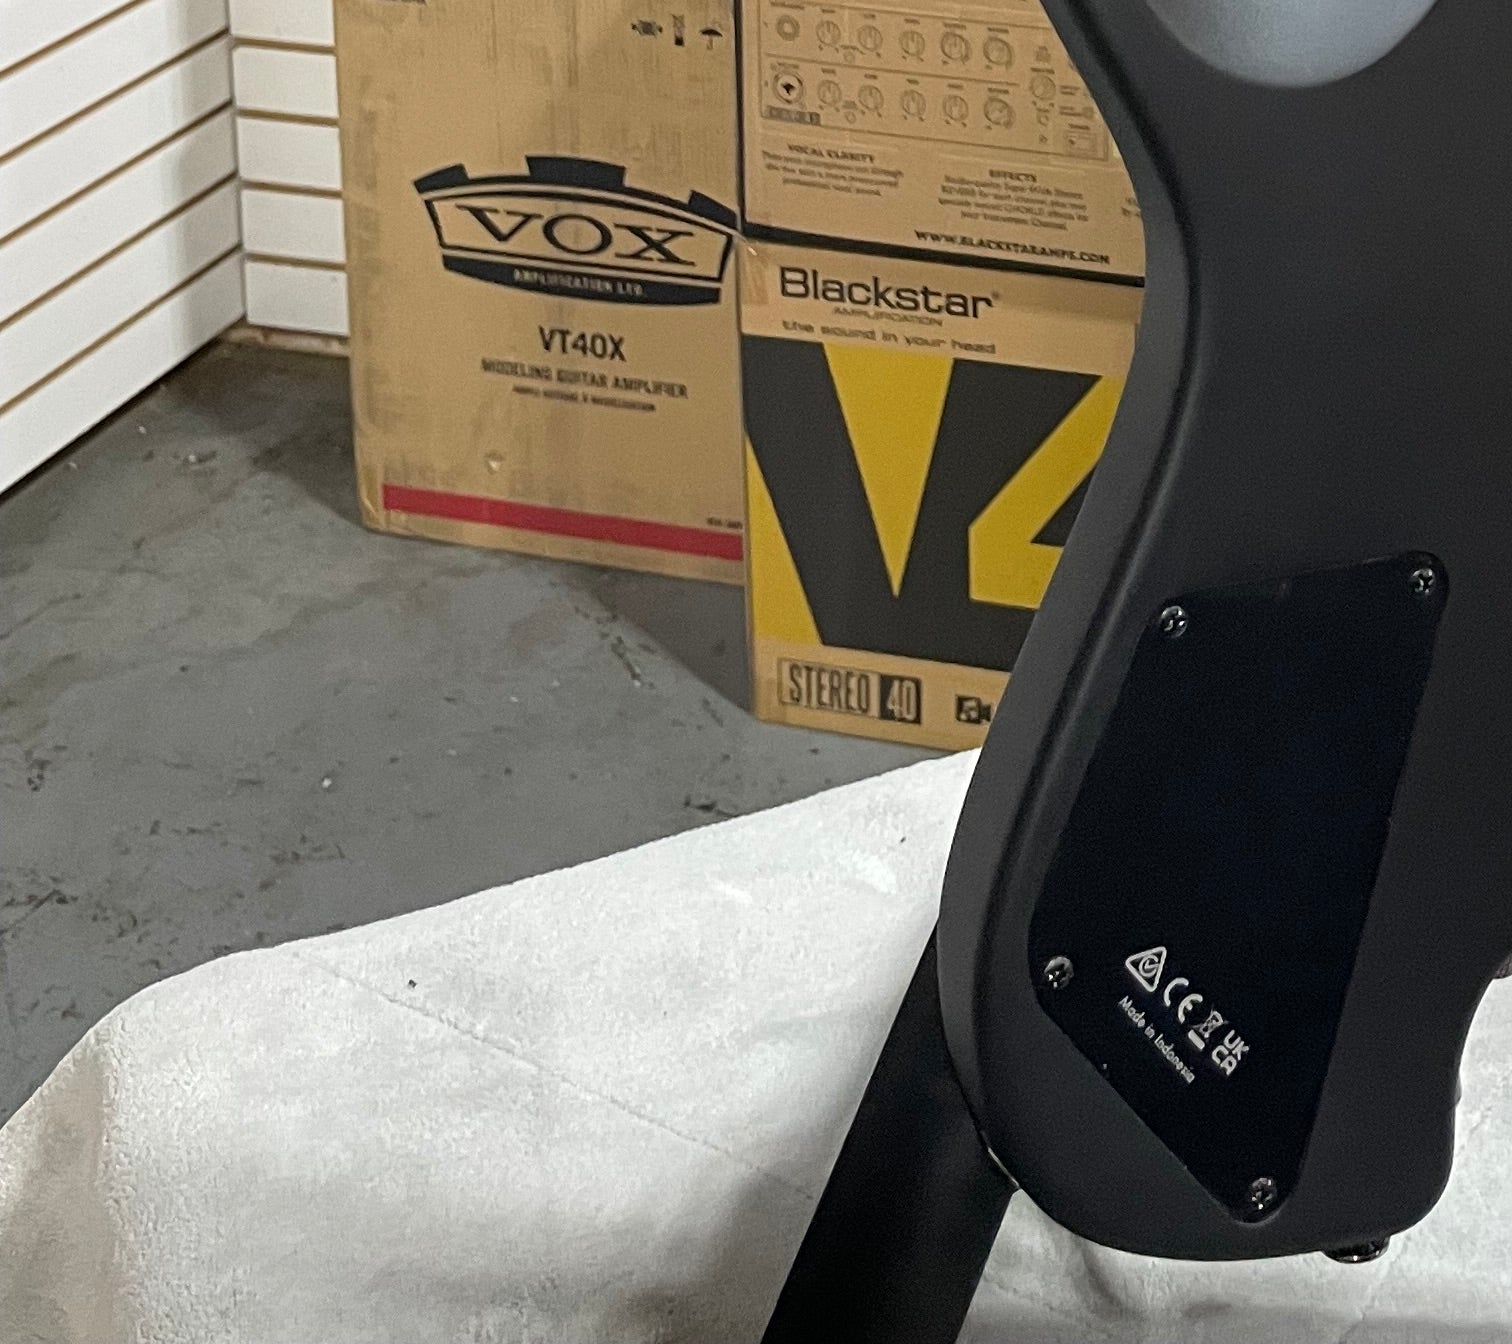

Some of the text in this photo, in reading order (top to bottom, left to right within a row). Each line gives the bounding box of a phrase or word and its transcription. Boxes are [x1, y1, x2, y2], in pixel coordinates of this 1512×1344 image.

[455, 204, 696, 267] VOX
[778, 265, 994, 318] Blackstar
[538, 325, 627, 362] VT40X
[782, 319, 997, 355] the sound in your head
[788, 663, 920, 721] STEREO 40
[1117, 994, 1146, 1028] Made
